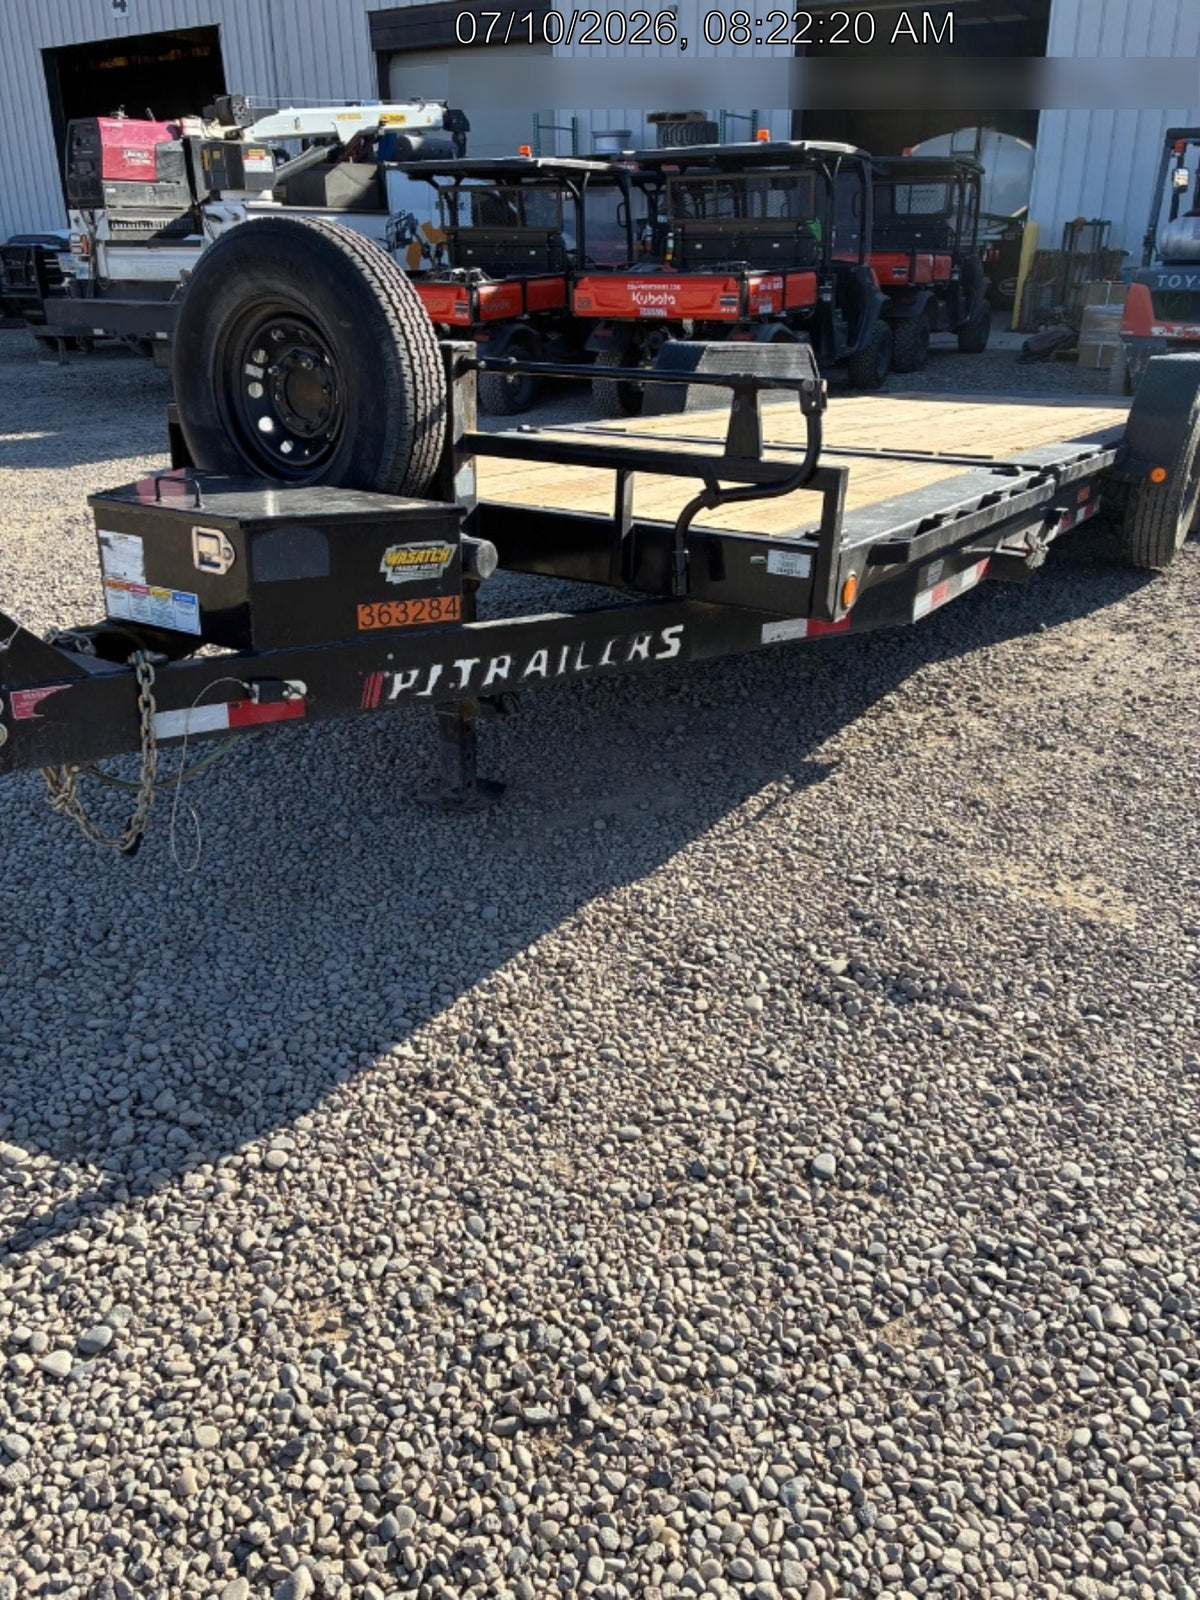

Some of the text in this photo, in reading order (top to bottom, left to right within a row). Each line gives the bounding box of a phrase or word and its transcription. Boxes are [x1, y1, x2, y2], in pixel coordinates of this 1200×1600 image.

[1157, 274, 1200, 289] TOY
[632, 291, 676, 305] Kubota
[386, 548, 451, 566] WASATCH
[361, 597, 458, 627] 363284
[388, 663, 443, 699] PJ
